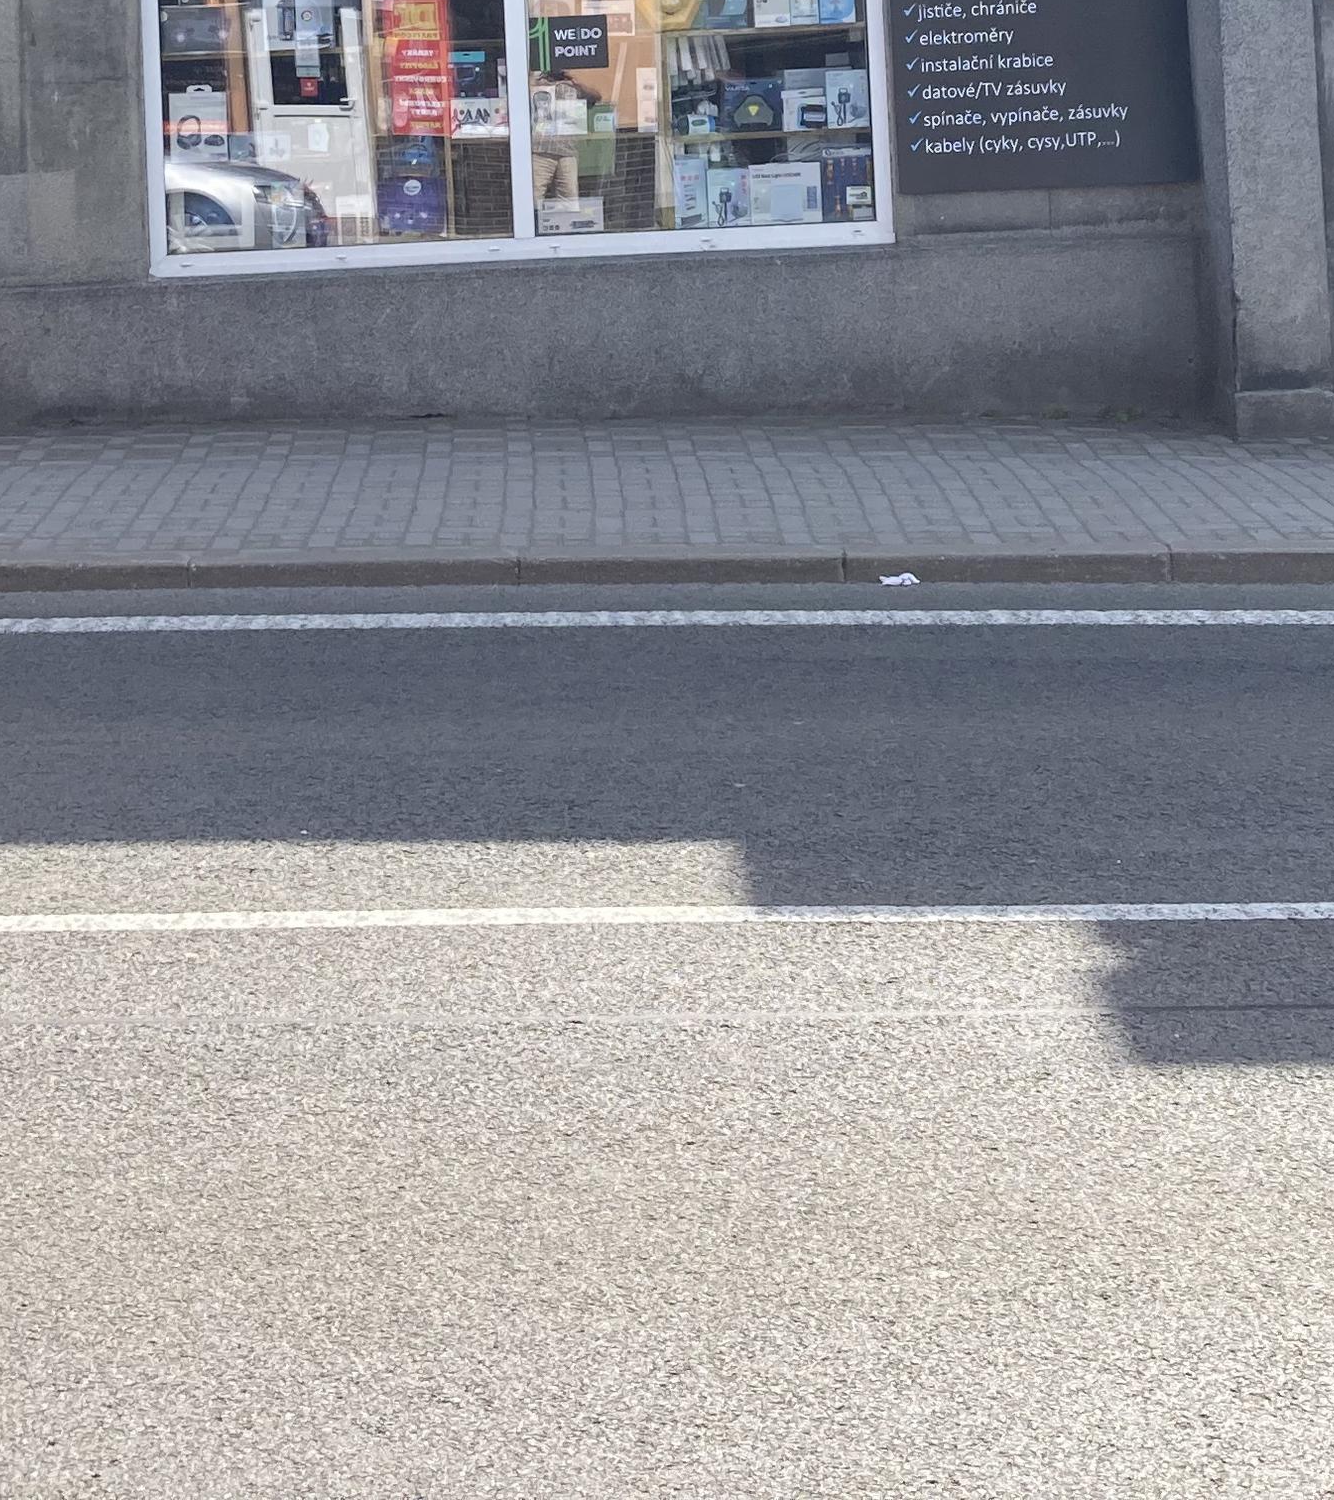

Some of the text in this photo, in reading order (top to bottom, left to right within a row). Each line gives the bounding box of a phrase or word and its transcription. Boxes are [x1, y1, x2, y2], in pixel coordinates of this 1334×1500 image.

[918, 0, 1037, 22] jističe, chrániče
[919, 28, 1014, 46] elektroměry
[555, 44, 597, 57] POINT
[921, 53, 1054, 73] instalační krabice
[922, 80, 1066, 100] datové/TV zásuvky
[923, 103, 1128, 128] spínače, vypínače, zásuvky
[924, 137, 975, 155] kabely
[979, 135, 1023, 153] (cyky,
